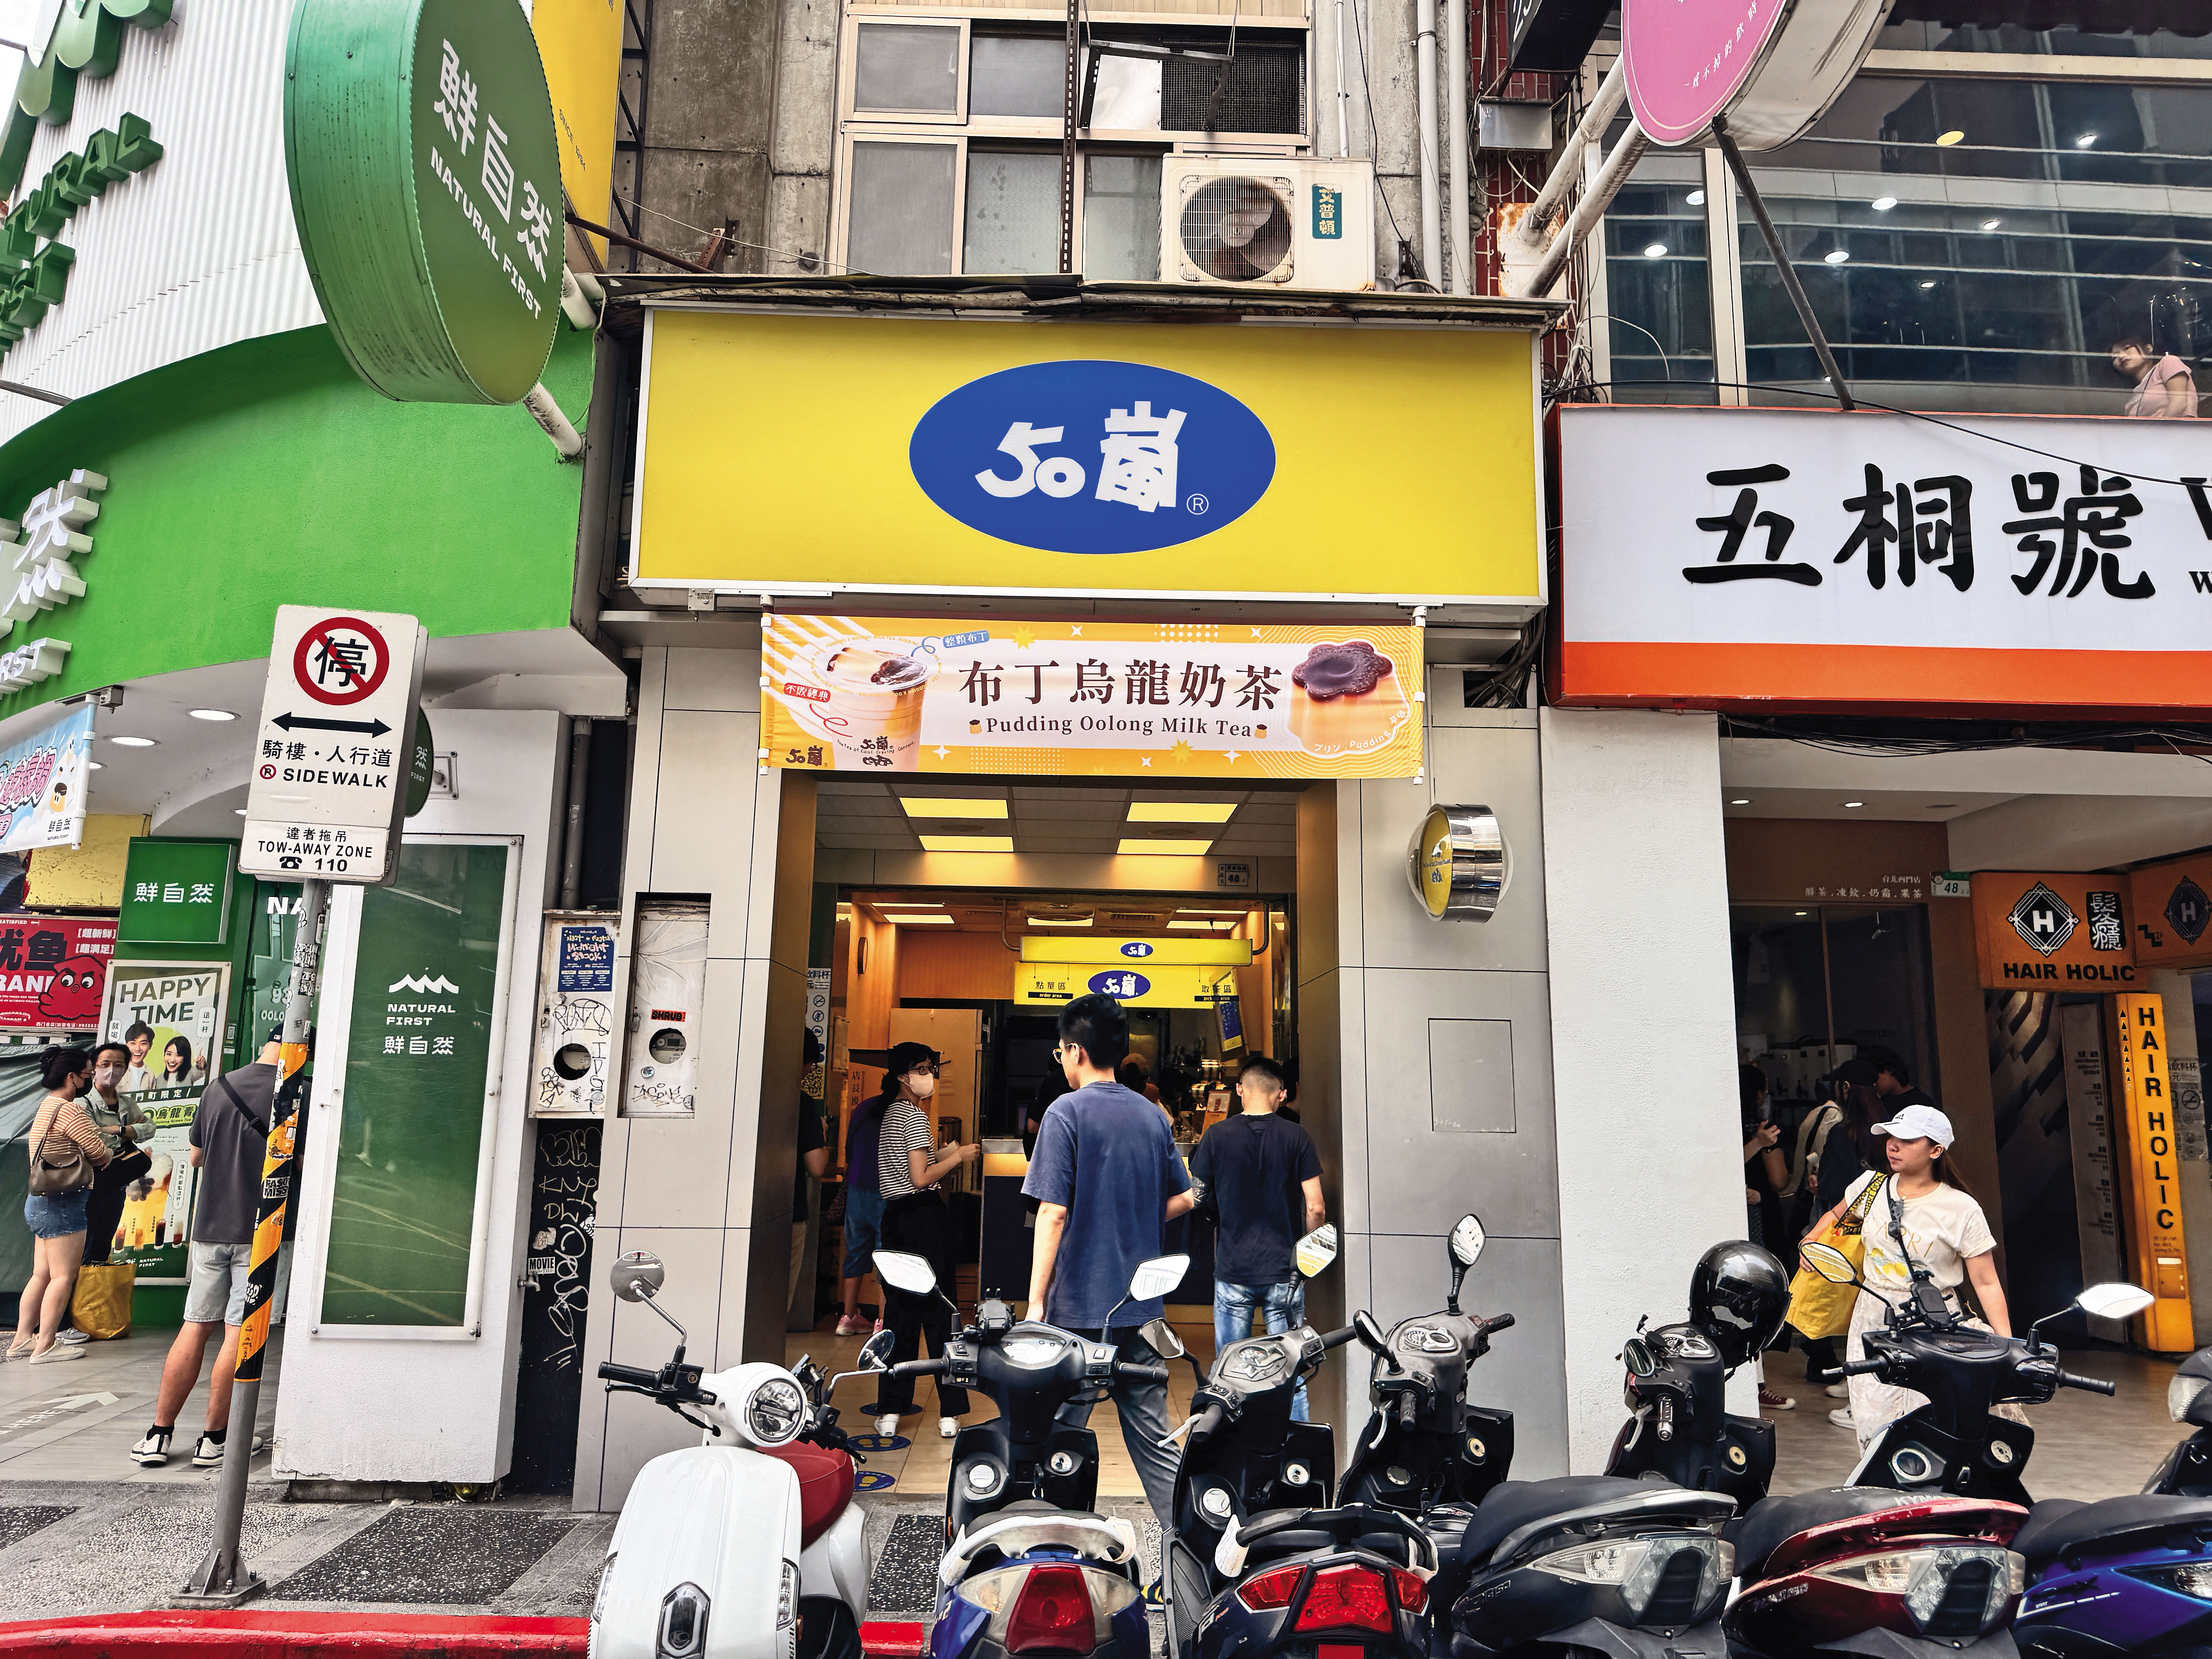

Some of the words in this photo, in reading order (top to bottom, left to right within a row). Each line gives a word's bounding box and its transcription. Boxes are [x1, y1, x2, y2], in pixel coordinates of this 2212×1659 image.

[434, 38, 552, 283] 鮮自然
[0, 111, 159, 267] TURAL
[430, 146, 499, 261] NATURAL
[502, 252, 542, 319] FIRST
[974, 401, 1187, 512] 50嵐
[1682, 463, 2156, 599] 五桐號
[945, 632, 988, 647] 整顆布丁
[314, 636, 369, 687] 停
[785, 684, 828, 701] 不敗經典
[958, 658, 1283, 711] 布丁烏龍奶茶
[986, 716, 1072, 735] Pudding
[1080, 715, 1153, 736] Oolong
[1161, 716, 1207, 734] Milk
[1216, 721, 1251, 737] Tea
[1350, 730, 1392, 749] Pudding
[785, 745, 823, 766] 50嵐
[283, 768, 389, 788] SIDEWALK
[286, 827, 348, 842] 違者拖吊
[258, 841, 331, 857] TOW-AWAY
[335, 843, 373, 858] ZONE
[315, 857, 348, 872] 110
[134, 882, 214, 903] 鮮自然
[1944, 883, 1958, 893] 48
[2033, 910, 2054, 933] H
[2182, 901, 2196, 922] H
[567, 942, 610, 953] Midnight
[571, 951, 602, 961] Snack
[1128, 943, 1146, 956] 50嵐
[2003, 962, 2059, 979] HAIR
[2066, 964, 2135, 981] HOLIC
[120, 976, 211, 1003] HAPPY
[1102, 974, 1138, 996] 50嵐
[131, 1001, 194, 1024] TIME
[388, 1003, 456, 1013] NATURAL
[652, 1011, 682, 1021] SHRUB
[386, 1017, 433, 1025] FIRST
[383, 1036, 455, 1054] 鮮自然
[2138, 1007, 2162, 1097] HAIR
[2147, 1111, 2174, 1230] HOLIC
[529, 1258, 554, 1270] MOVIE
